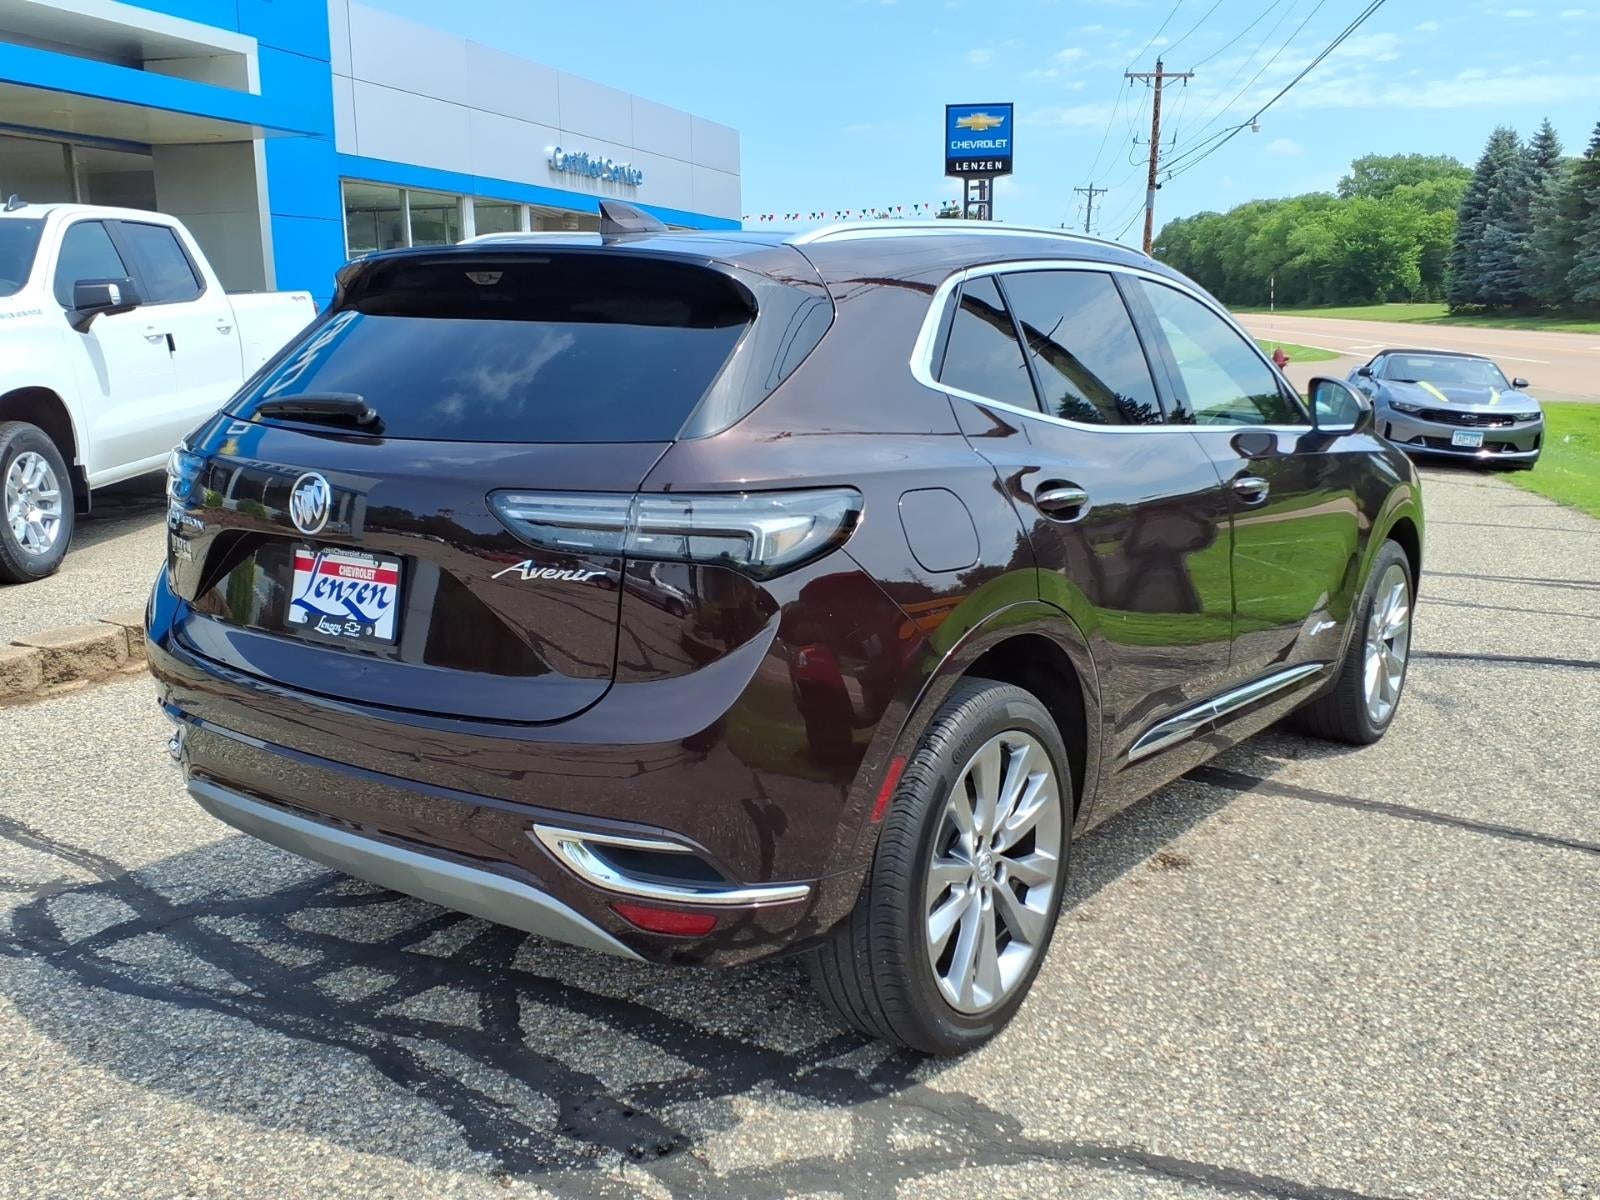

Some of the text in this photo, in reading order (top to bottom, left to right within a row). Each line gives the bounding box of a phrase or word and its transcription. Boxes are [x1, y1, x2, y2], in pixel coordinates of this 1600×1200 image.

[951, 139, 1008, 150] CHEVROLET
[548, 146, 643, 186] Certified Service
[955, 161, 1003, 171] LENZEN
[338, 564, 377, 580] CHEVROLET
[491, 559, 607, 582] Avenir
[291, 551, 393, 625] Lenzen
